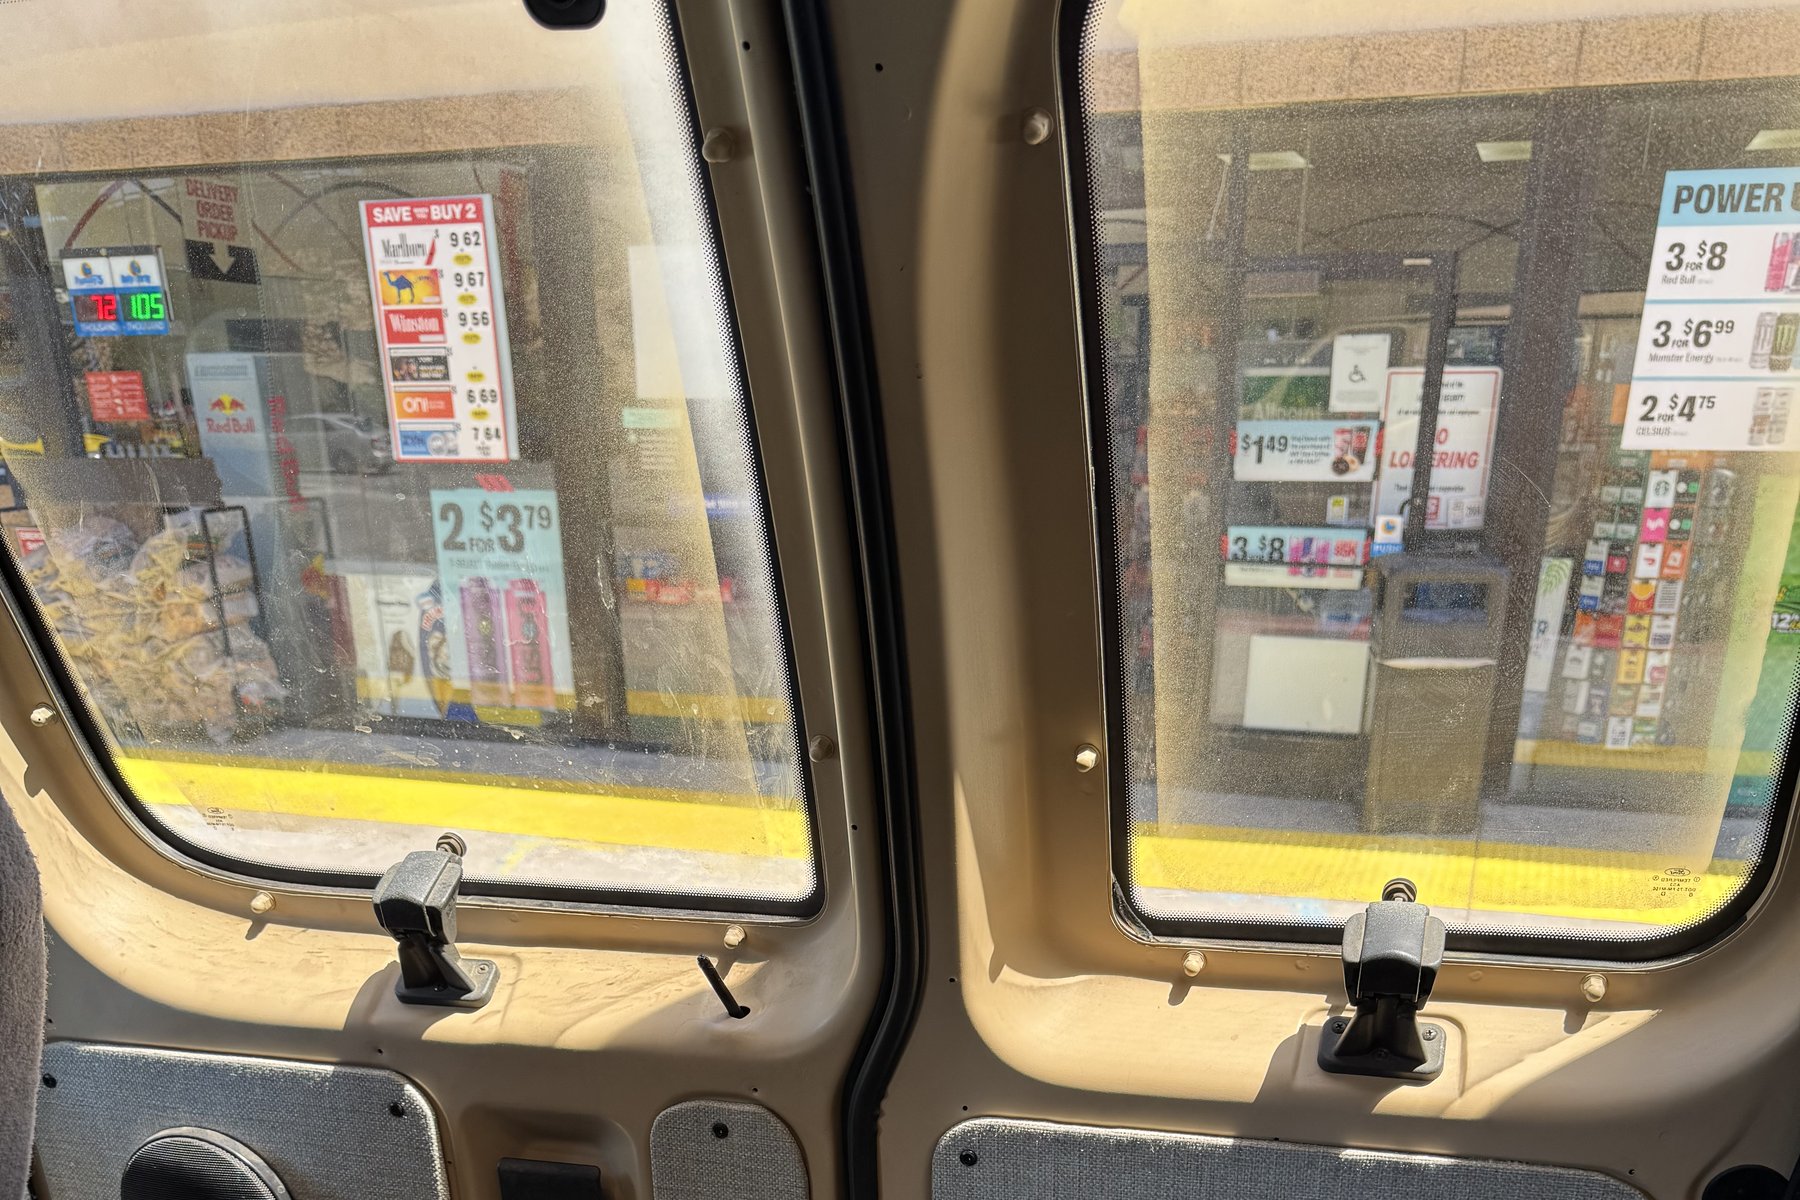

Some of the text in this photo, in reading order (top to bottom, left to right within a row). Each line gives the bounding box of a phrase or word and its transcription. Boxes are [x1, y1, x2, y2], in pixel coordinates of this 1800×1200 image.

[185, 178, 238, 202] DELIVERY
[1673, 182, 1785, 214] POWER
[196, 200, 233, 223] ORDER
[373, 205, 413, 223] SAVE
[430, 204, 464, 220] BUY
[465, 203, 477, 219] 2
[197, 220, 238, 242] PICKUP
[1665, 240, 1728, 271] 3 FOR $8
[1661, 275, 1678, 285] Red
[1679, 275, 1696, 285] Bull
[90, 295, 117, 320] 72
[131, 293, 165, 319] 105
[1652, 320, 1672, 348] 3
[1649, 353, 1684, 363] Monster
[1685, 353, 1714, 364] Energy
[1639, 395, 1658, 422] 2
[1636, 426, 1672, 436] CELSIUS
[440, 502, 466, 551] 2
[469, 537, 495, 553] FOR
[1232, 536, 1248, 561] 3
